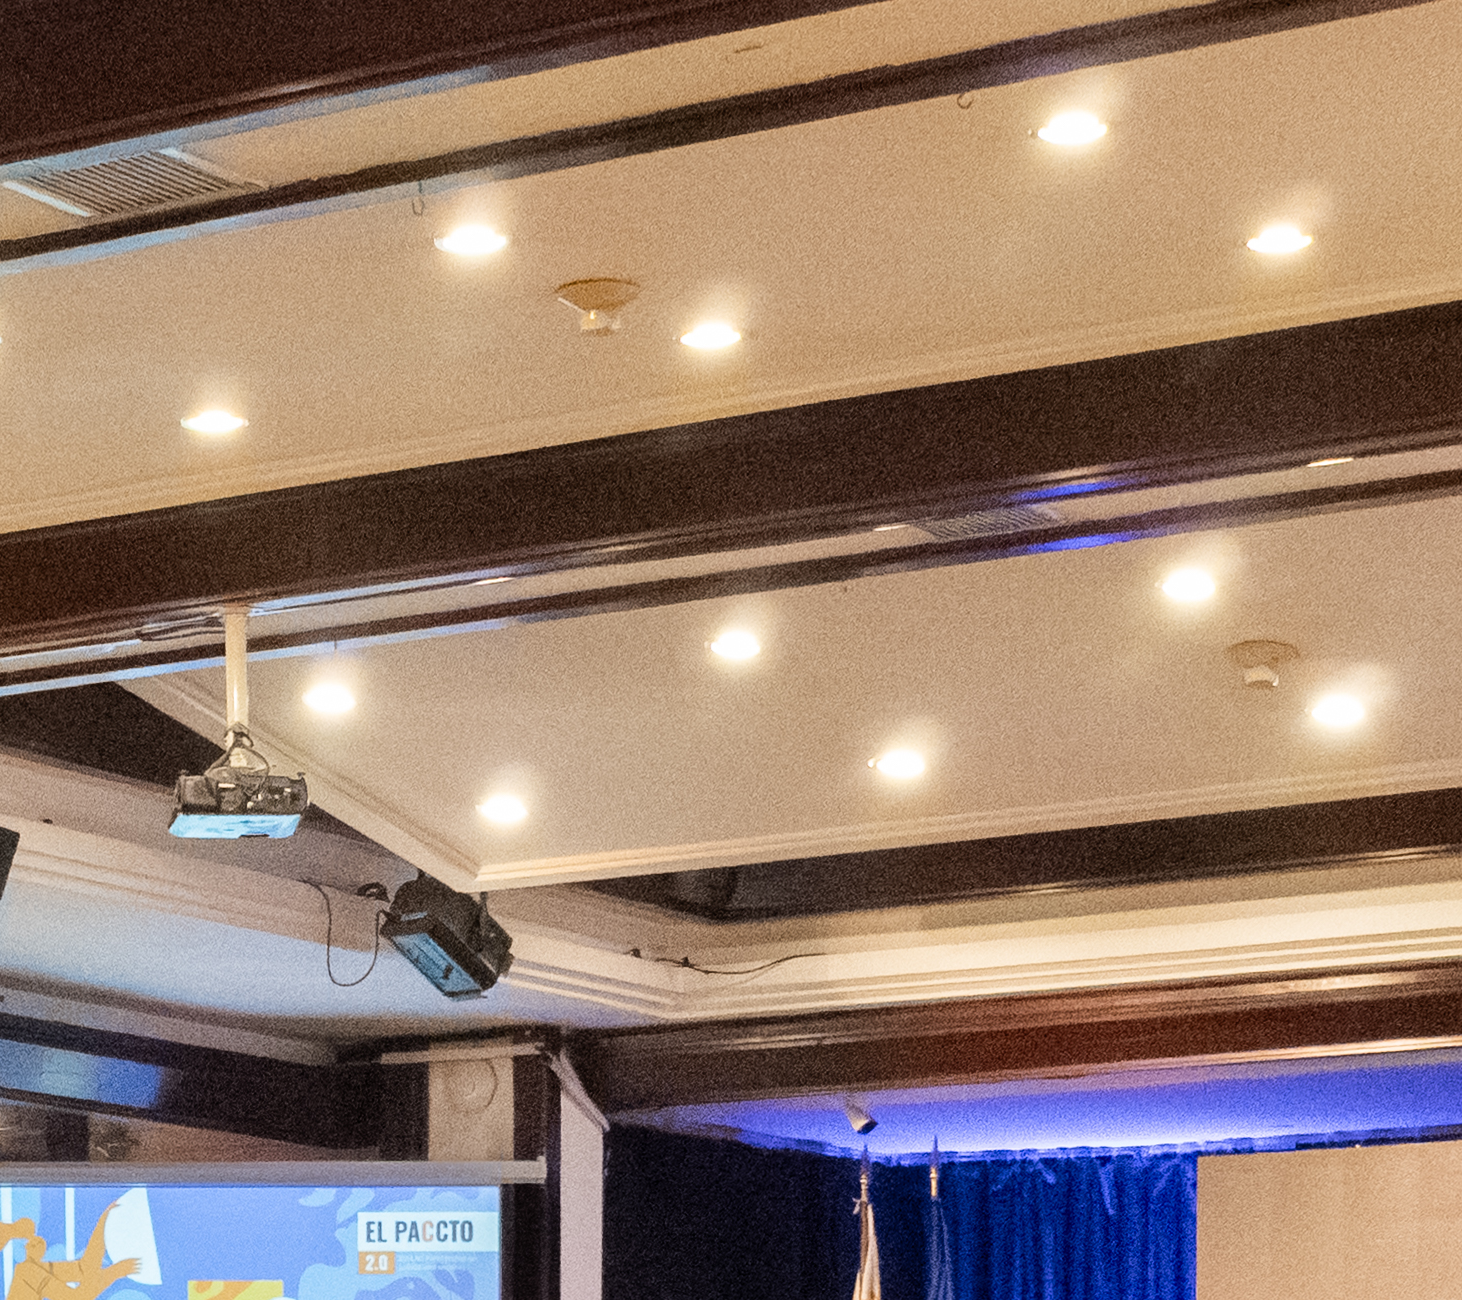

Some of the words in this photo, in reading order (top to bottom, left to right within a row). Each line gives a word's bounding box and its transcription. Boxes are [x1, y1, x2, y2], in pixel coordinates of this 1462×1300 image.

[366, 1221, 387, 1242] EL
[394, 1220, 473, 1242] PACCTO
[365, 1254, 388, 1271] 2.0
